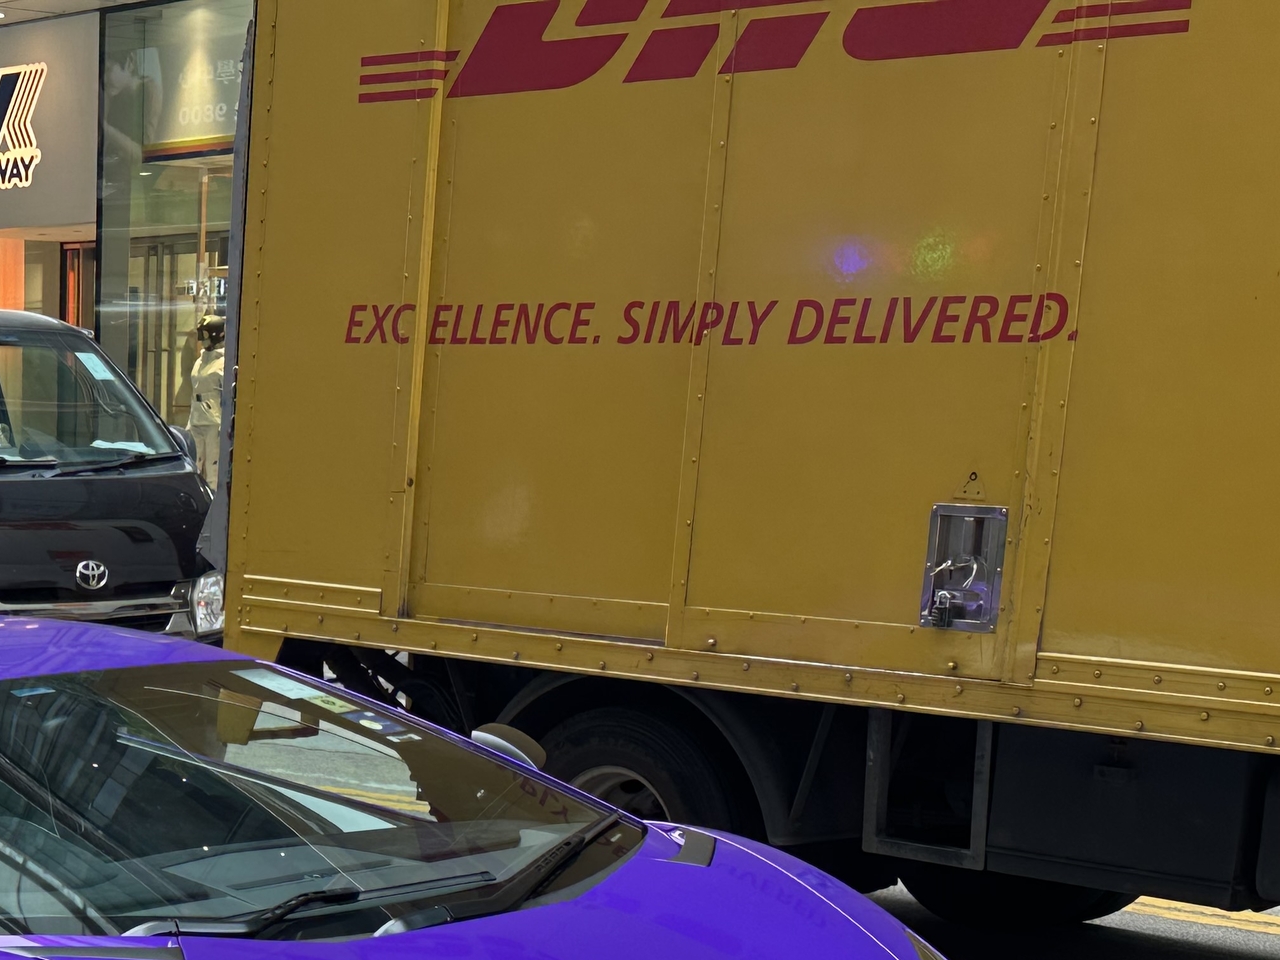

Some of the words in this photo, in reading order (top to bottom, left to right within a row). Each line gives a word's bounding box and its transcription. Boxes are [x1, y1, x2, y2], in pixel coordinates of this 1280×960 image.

[343, 302, 601, 346] EXCELLENCE.
[616, 299, 780, 347] SIMPLY
[786, 292, 1079, 346] DELIVERED.
